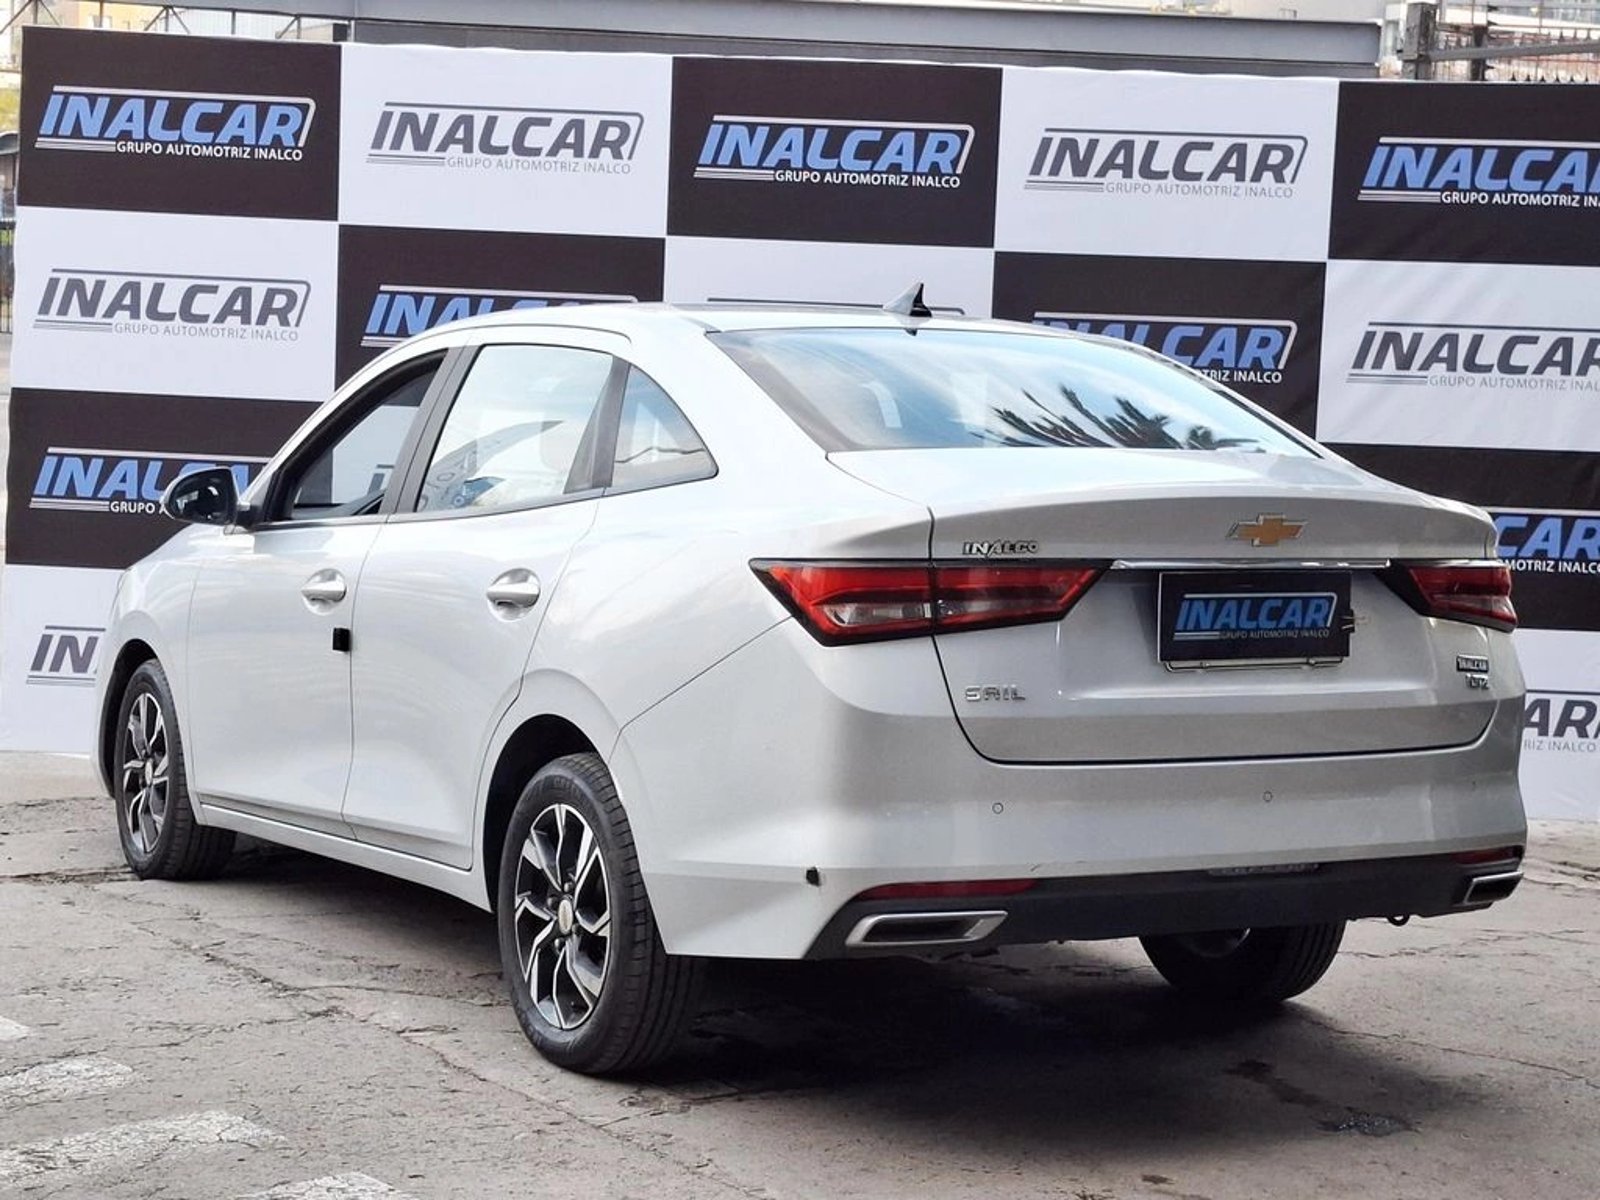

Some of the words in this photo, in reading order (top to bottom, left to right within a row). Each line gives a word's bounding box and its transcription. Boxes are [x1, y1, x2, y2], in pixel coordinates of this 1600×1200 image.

[39, 94, 303, 147] INALCAR
[371, 110, 631, 160] INALCAR
[117, 141, 163, 155] GRUPO
[166, 143, 251, 158] AUTOMOTRIZ
[254, 148, 303, 161] INALCO
[699, 124, 961, 174] INALCAR
[447, 156, 492, 169] GRUPO
[496, 158, 580, 173] AUTOMOTRIZ
[584, 162, 631, 174] INALCO
[1029, 137, 1295, 184] INALCAR
[1362, 145, 1600, 193] INALCA
[775, 170, 820, 183] GRUPO
[824, 172, 909, 187] AUTOMOTRIZ
[912, 175, 960, 188] INALCO
[1106, 182, 1151, 194] GRUPO
[1155, 184, 1241, 197] AUTOMOTRIZ
[1245, 186, 1293, 199] INALCO
[1442, 191, 1488, 204] GRUPO
[1492, 193, 1580, 207] AUTOMOTRIZ
[1584, 195, 1600, 207] IN
[38, 277, 299, 327] INALCAR
[114, 323, 159, 335] GRUPO
[163, 325, 247, 340] AUTOMOTRIZ
[251, 328, 298, 342] INALCO
[1233, 370, 1282, 384] INALCO
[1429, 375, 1475, 387] GRUPO
[1480, 377, 1566, 391] AUTOMOTRIZ
[33, 456, 250, 500] INAL
[110, 500, 155, 514] GRUPO
[963, 540, 1039, 557] INALCO
[1175, 599, 1330, 631] INALCAR
[1221, 631, 1247, 640] GRUPO
[1250, 630, 1298, 639] AUTOMOTRIZ
[30, 634, 98, 673] IN
[965, 685, 1026, 702] SAIL
[1548, 740, 1596, 752] INALCO
